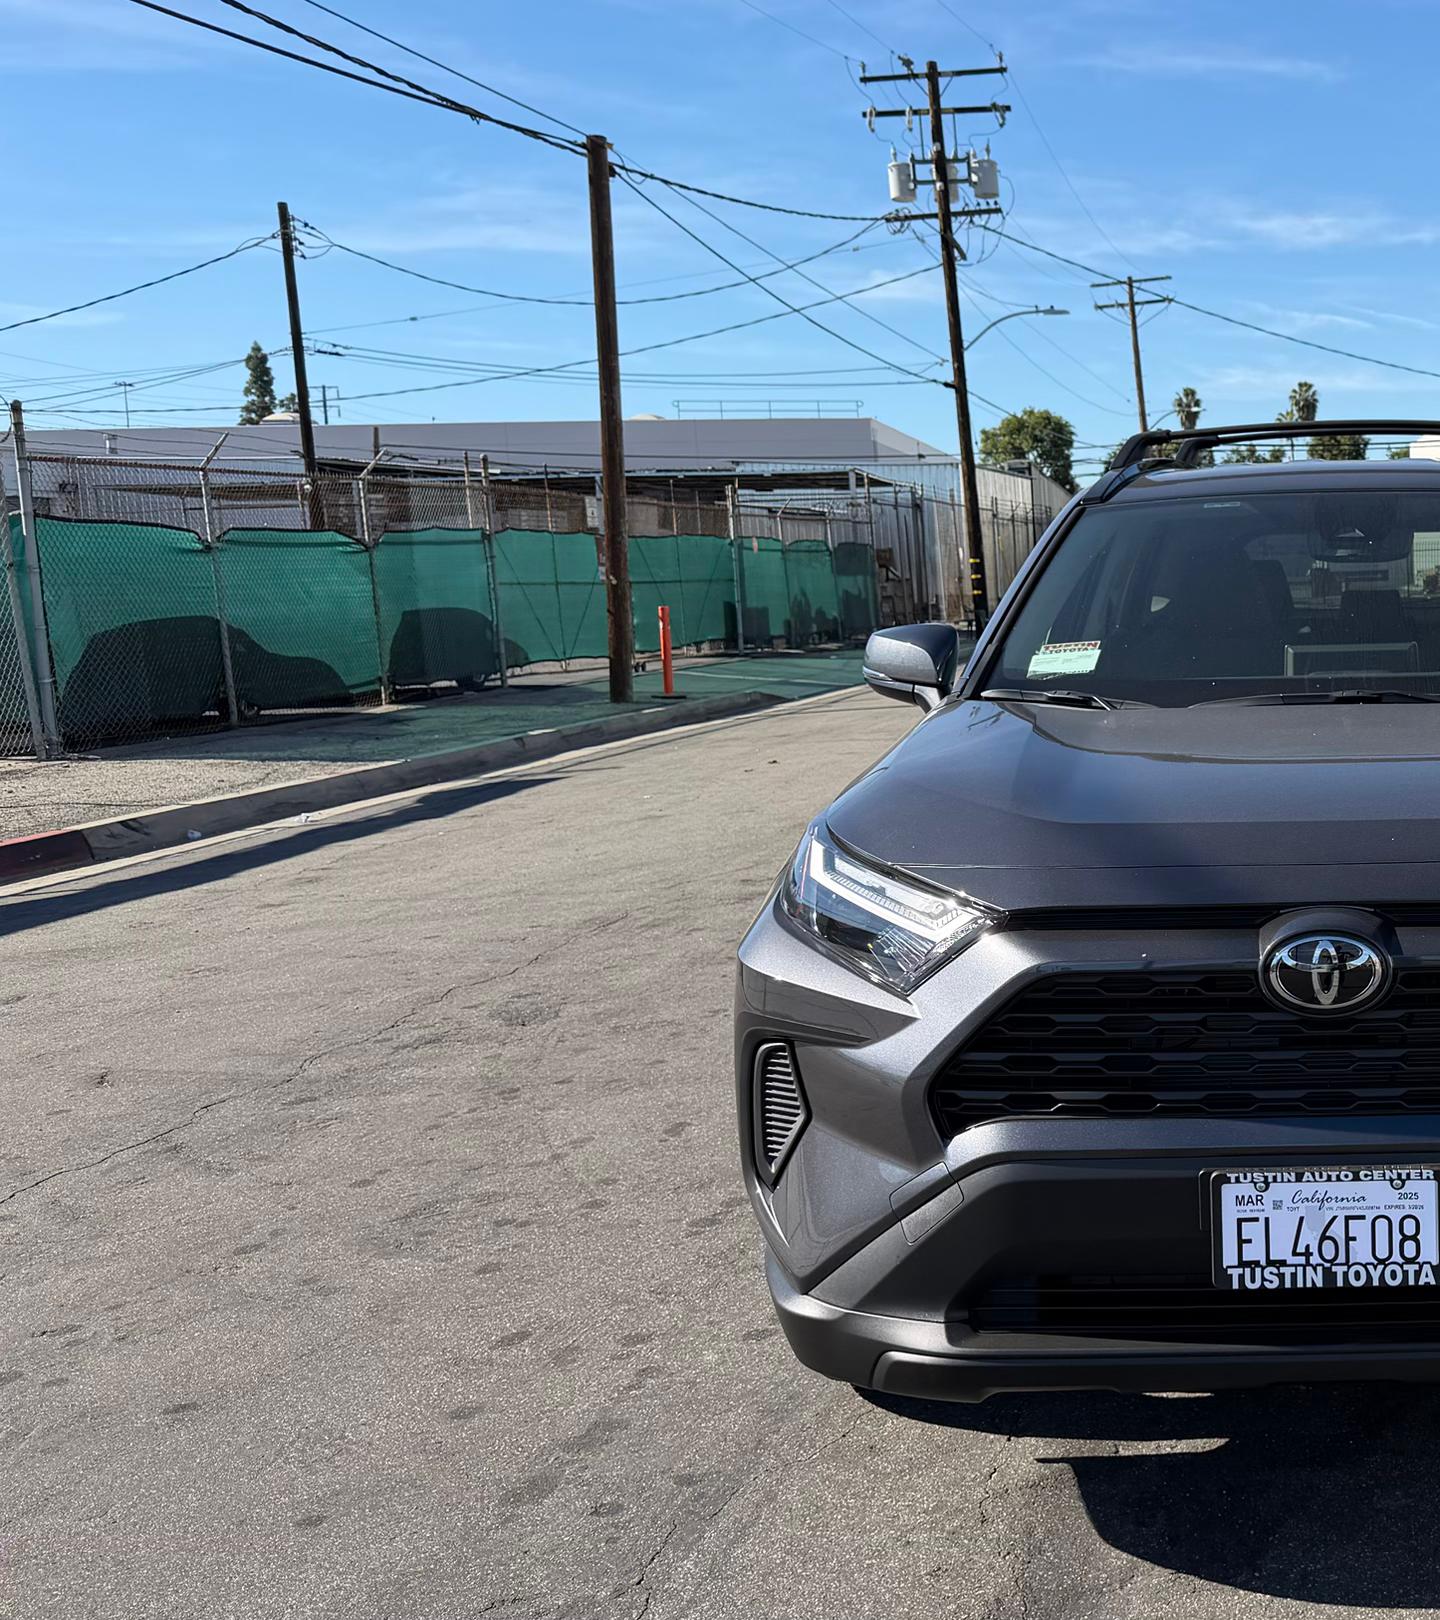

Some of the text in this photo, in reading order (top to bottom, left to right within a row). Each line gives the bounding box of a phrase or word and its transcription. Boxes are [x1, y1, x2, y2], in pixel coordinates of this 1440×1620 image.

[1227, 1169, 1434, 1183] TUSTIN AUTO CENTER
[1235, 1194, 1264, 1207] MAR
[1291, 1190, 1367, 1211] California
[1397, 1192, 1419, 1201] 2025
[1236, 1214, 1422, 1265] EL46F08
[1227, 1264, 1436, 1290] TUSTIN TOYOTA
